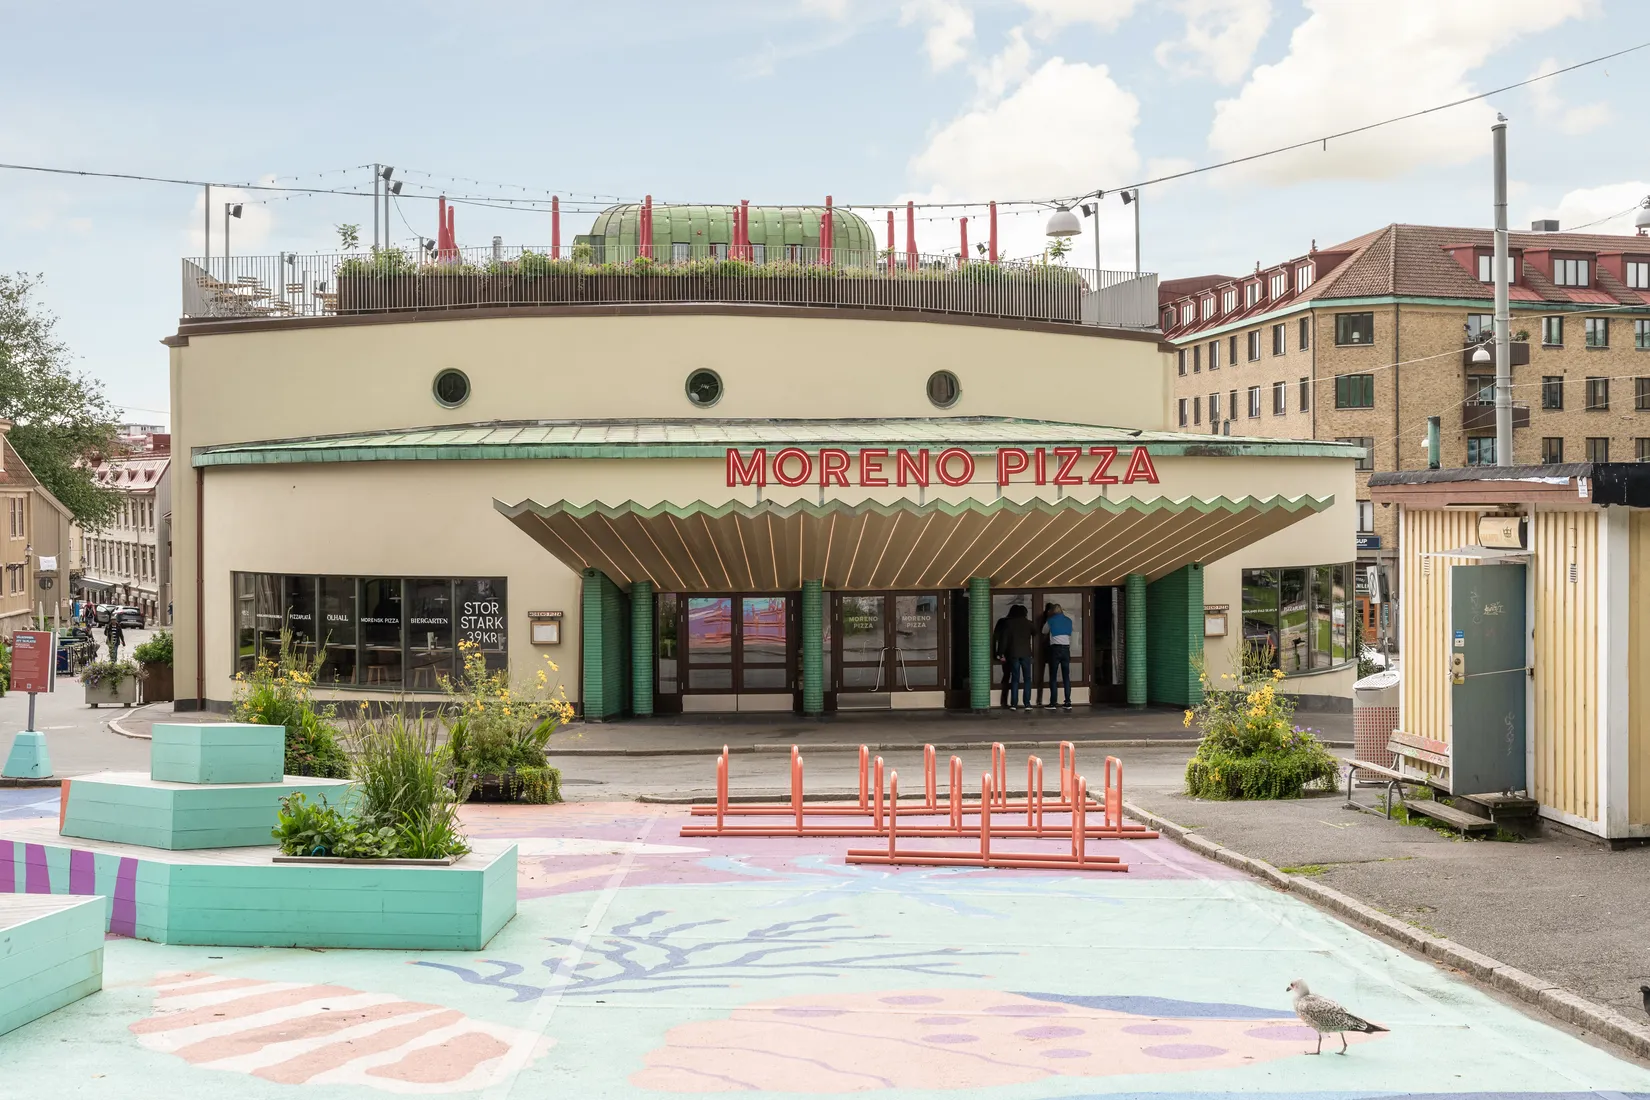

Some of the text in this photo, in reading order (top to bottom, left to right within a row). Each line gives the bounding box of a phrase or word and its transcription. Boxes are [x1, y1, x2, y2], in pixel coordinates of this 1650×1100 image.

[726, 446, 1160, 488] MORENO PIZZA
[464, 601, 499, 615] STOR
[460, 616, 504, 630] STARK
[466, 631, 498, 643] 39KR
